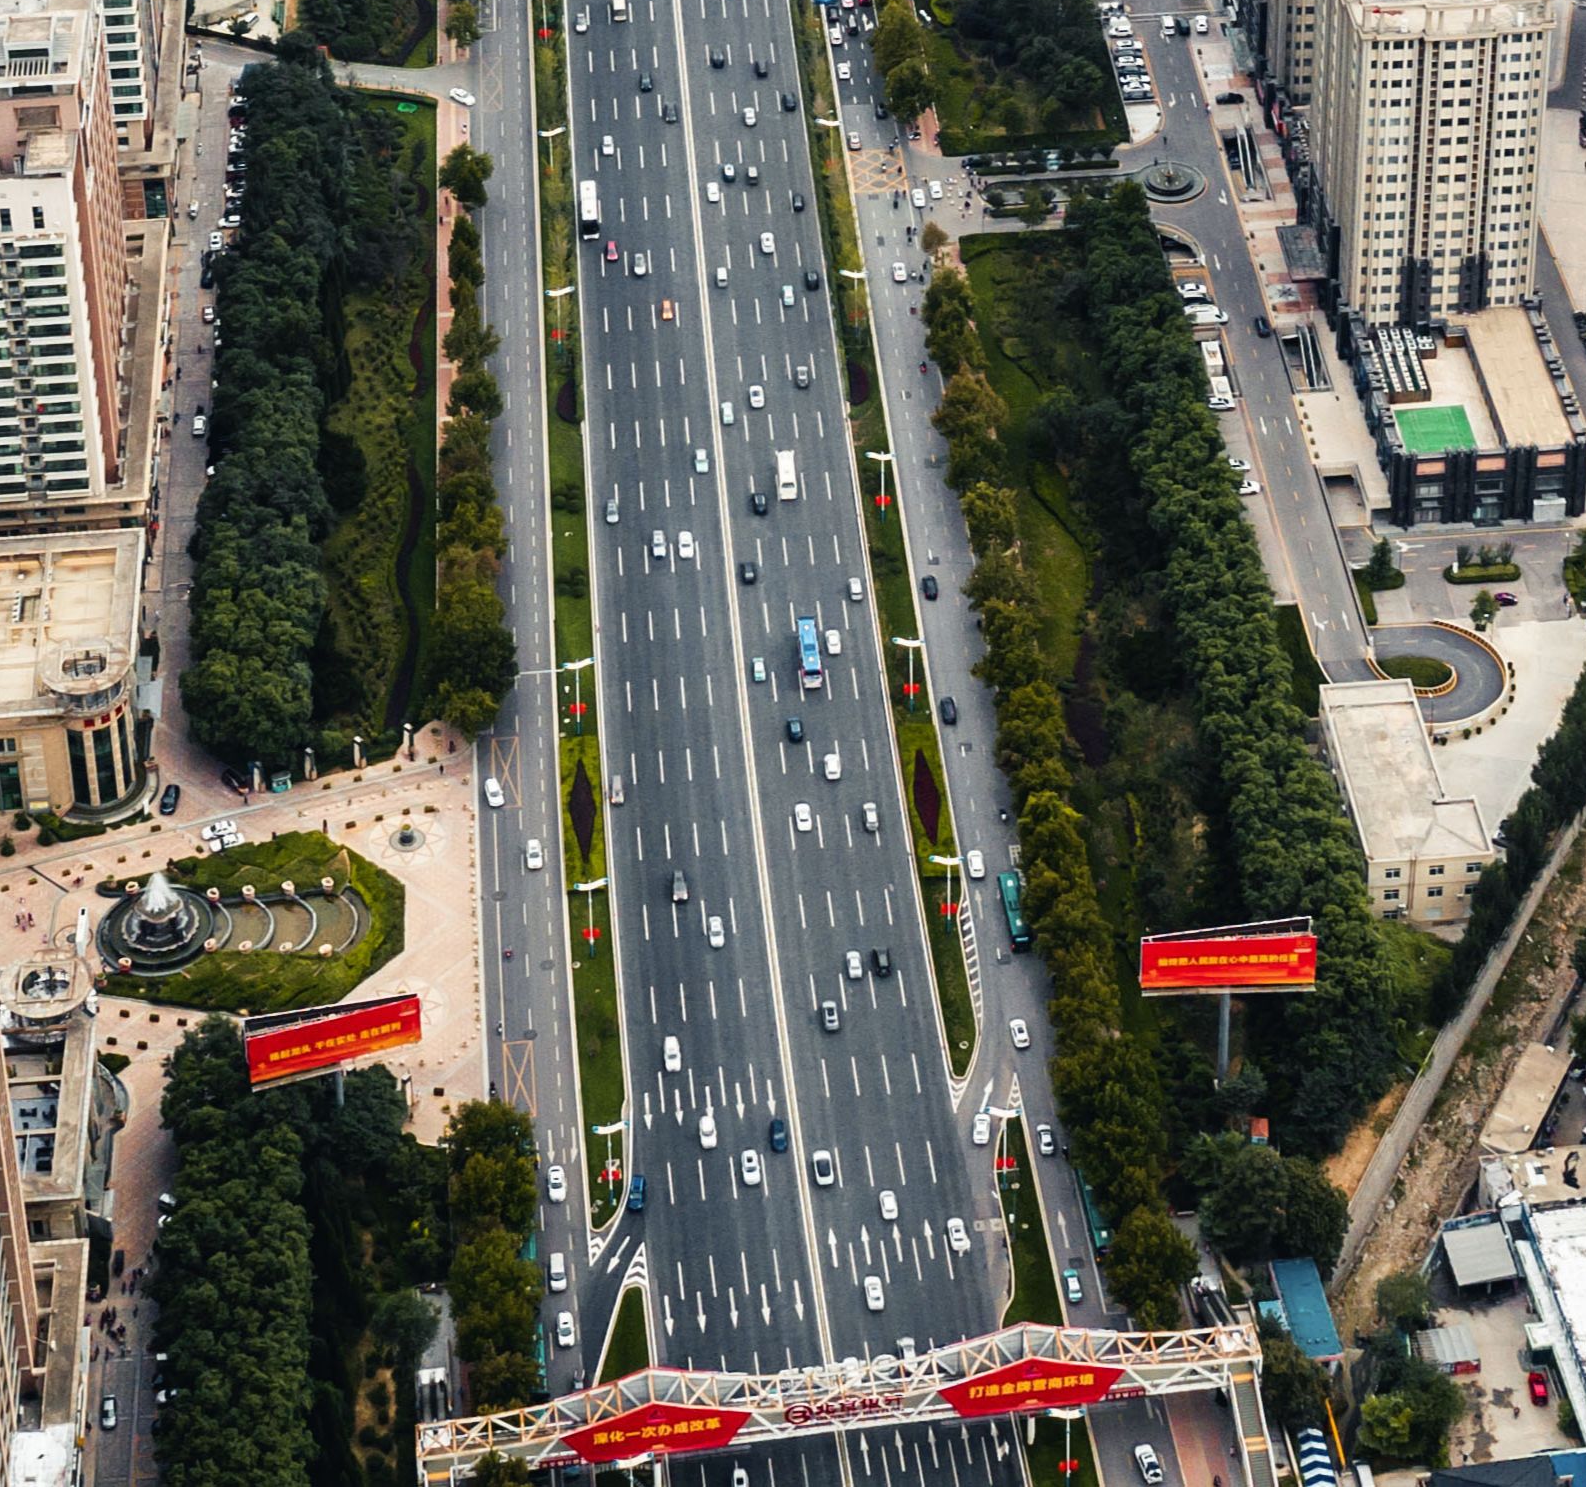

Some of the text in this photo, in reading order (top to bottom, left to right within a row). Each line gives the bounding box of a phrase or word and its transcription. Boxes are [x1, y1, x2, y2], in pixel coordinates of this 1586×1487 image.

[968, 1373, 1095, 1399] 打造金牌营商环境
[592, 1417, 721, 1445] 深化一次办成改革
